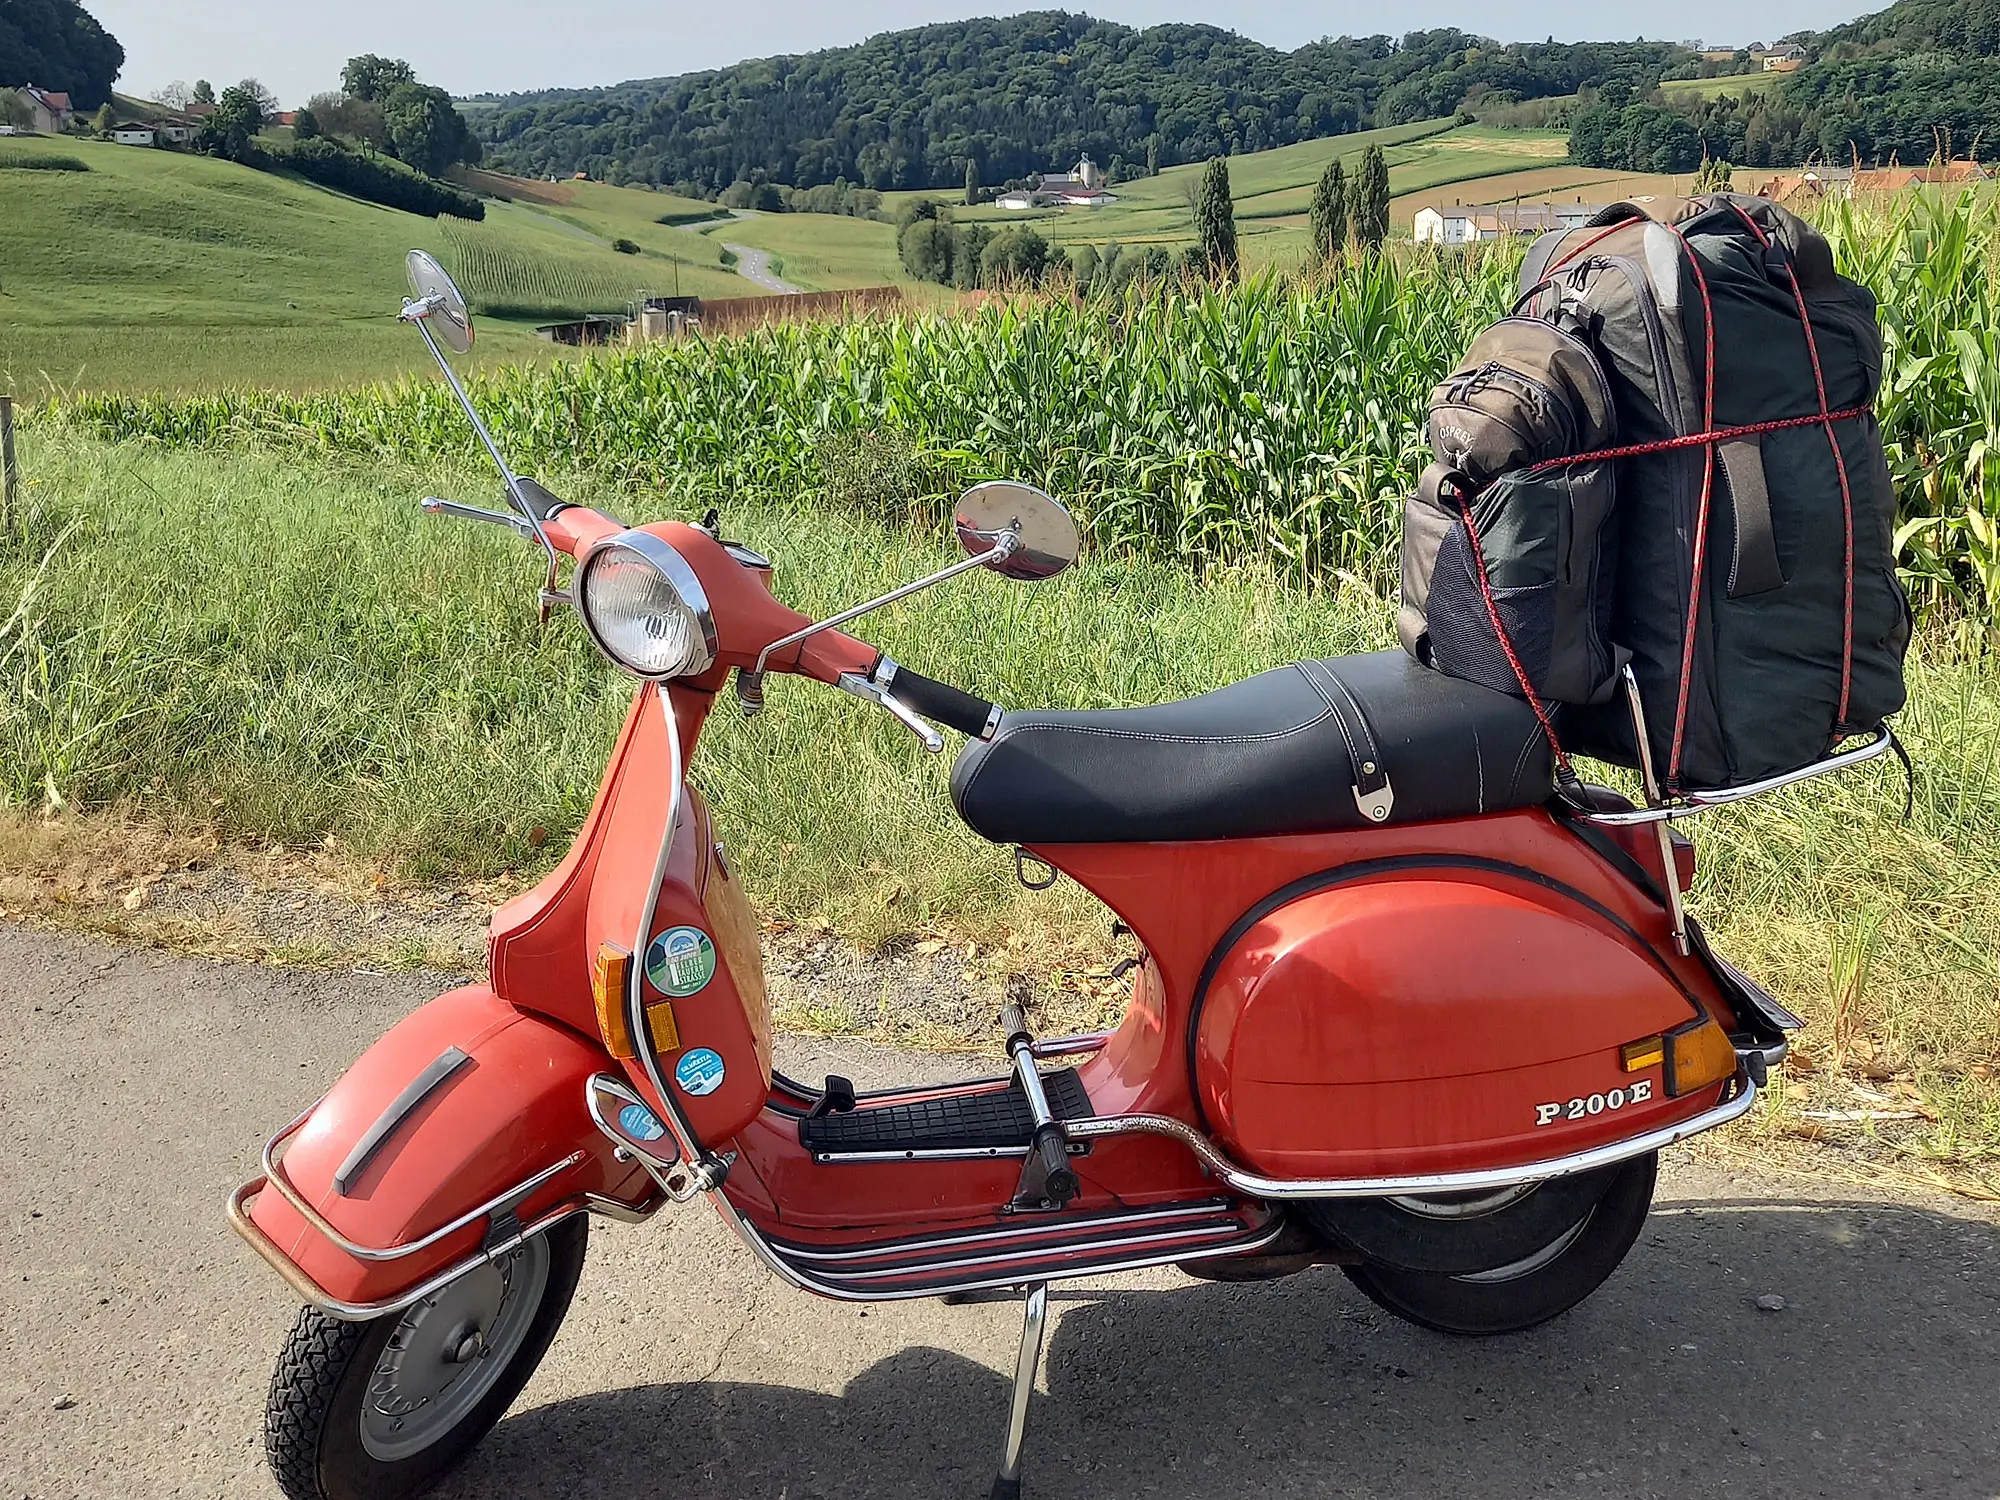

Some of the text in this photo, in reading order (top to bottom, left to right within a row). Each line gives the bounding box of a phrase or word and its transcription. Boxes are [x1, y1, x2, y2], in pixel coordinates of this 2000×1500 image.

[1439, 425, 1474, 445] OSPREY
[676, 956, 703, 969] FELBER
[678, 964, 705, 977] TAUERN
[679, 971, 706, 985] STRASSE
[1536, 1103, 1560, 1125] P
